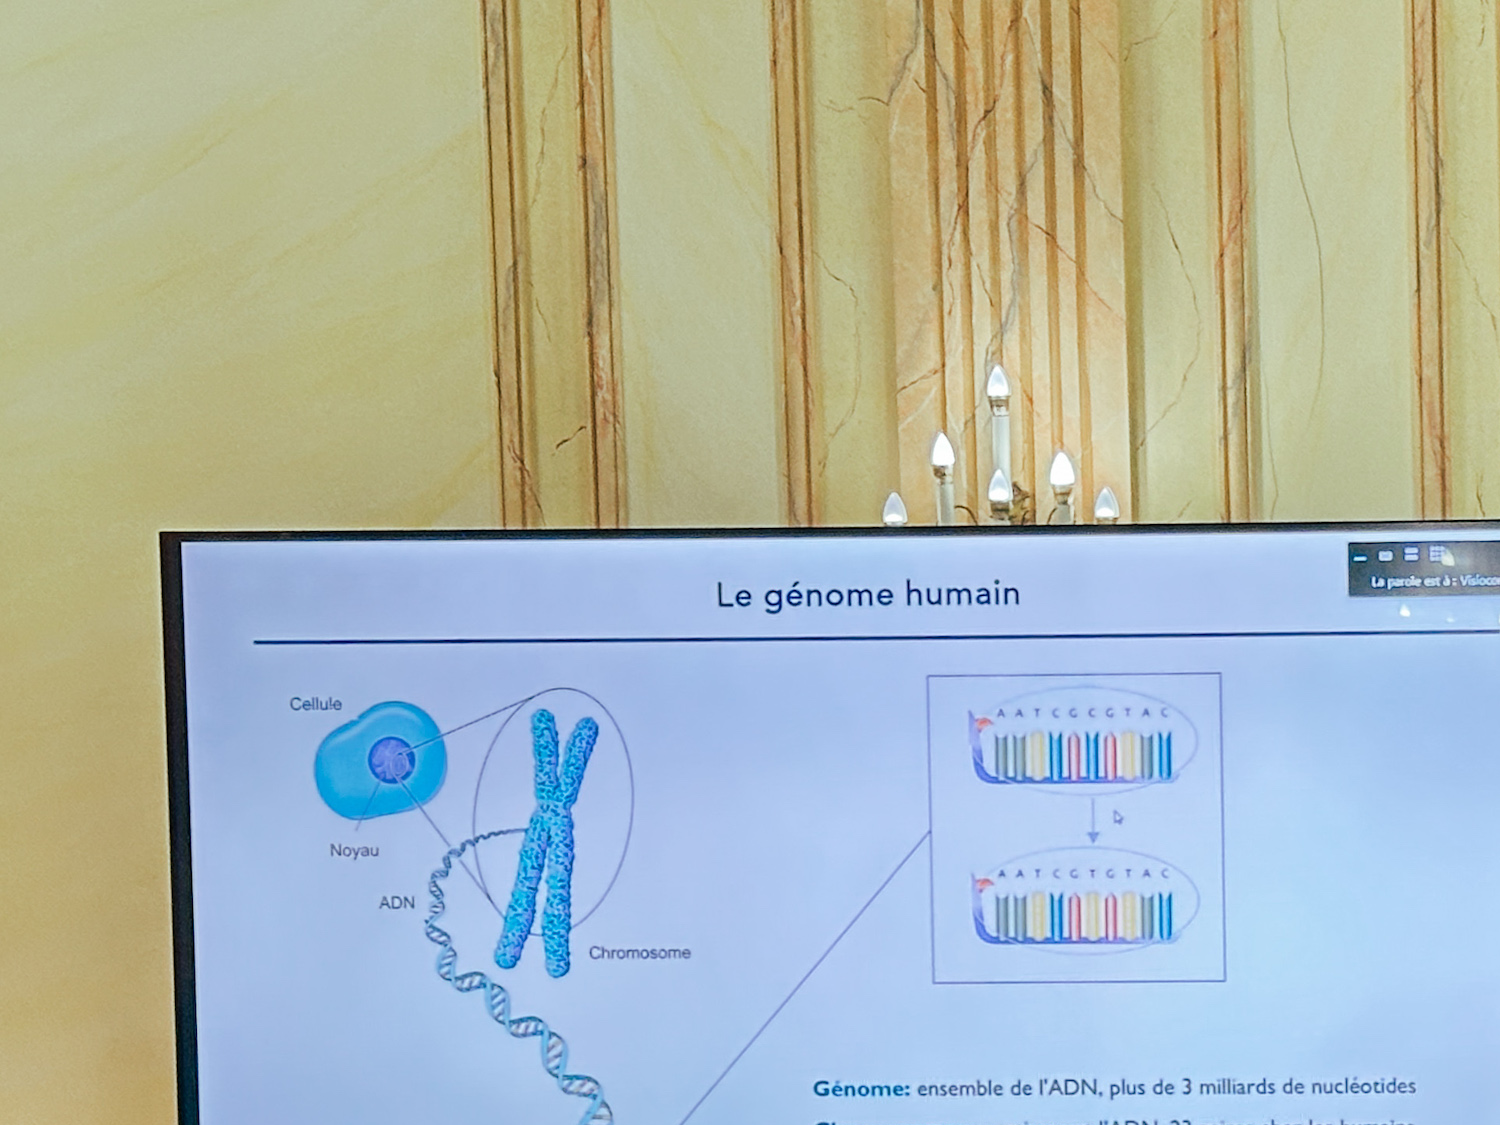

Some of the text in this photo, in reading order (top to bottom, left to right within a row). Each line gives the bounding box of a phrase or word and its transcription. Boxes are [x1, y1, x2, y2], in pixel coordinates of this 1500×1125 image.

[1387, 575, 1421, 589] parole
[1424, 576, 1441, 587] est
[717, 579, 1020, 614] Le génome humain
[289, 696, 343, 712] Cellule
[329, 842, 380, 860] Noyau
[379, 895, 416, 910] ADN
[588, 945, 691, 960] Chromosome
[813, 1079, 910, 1097] Génome:
[917, 1080, 1003, 1097] ensemble
[1010, 1079, 1032, 1096] de
[1109, 1078, 1146, 1100] plus
[1152, 1078, 1175, 1095] de
[1182, 1078, 1193, 1095] 3
[1199, 1077, 1276, 1095] milliards
[1282, 1077, 1305, 1095] de
[1311, 1076, 1417, 1094] nucléotides
